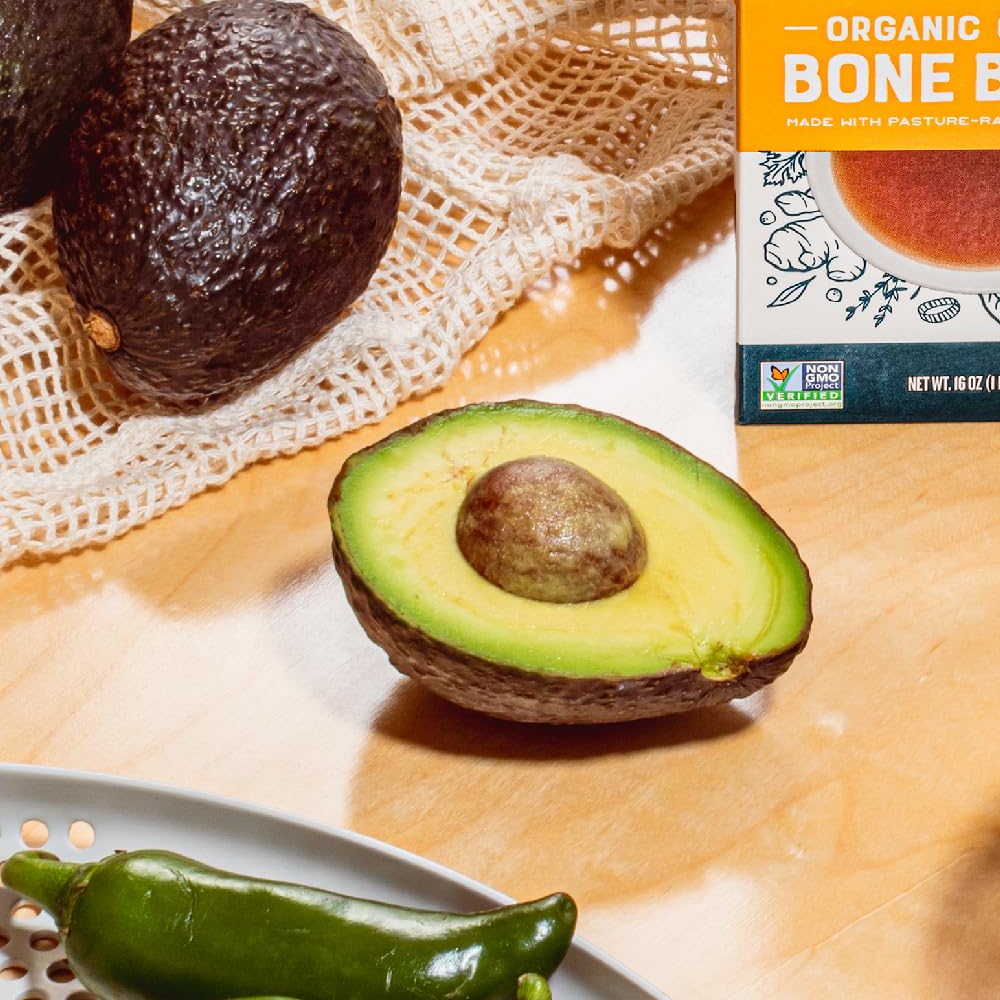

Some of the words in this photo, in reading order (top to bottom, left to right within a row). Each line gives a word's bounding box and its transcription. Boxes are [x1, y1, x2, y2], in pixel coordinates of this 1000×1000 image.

[826, 14, 981, 42] ORGANIC
[783, 52, 955, 104] BONE
[786, 117, 834, 127] MADE
[840, 117, 881, 127] WITH
[806, 364, 838, 373] NON
[805, 373, 840, 383] GMO
[805, 382, 840, 391] Project
[907, 375, 929, 392] NET
[931, 375, 951, 391] WT.
[953, 375, 967, 391] 16
[968, 375, 983, 390] OZ
[766, 391, 840, 400] VERIFIED
